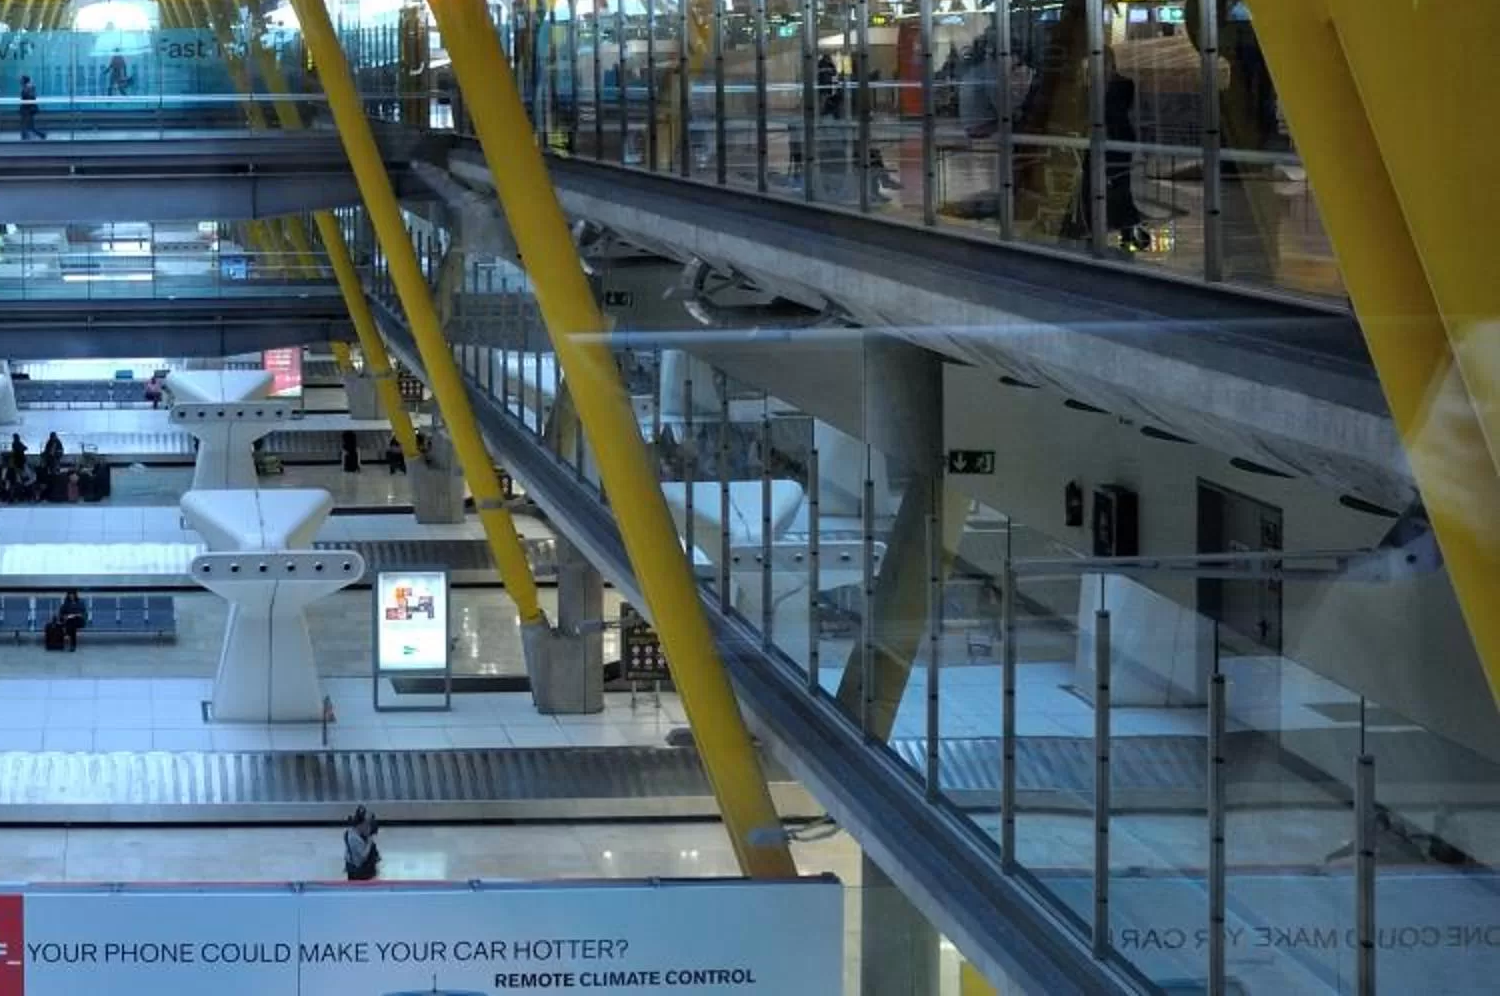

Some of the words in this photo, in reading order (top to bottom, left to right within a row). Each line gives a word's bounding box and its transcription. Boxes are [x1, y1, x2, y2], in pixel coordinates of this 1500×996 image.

[157, 38, 206, 59] Fast
[27, 943, 97, 963] YOUR
[104, 943, 194, 963] PHONE
[201, 942, 291, 963] COULD
[299, 942, 370, 963] MAKE
[376, 941, 447, 962] YOUR
[453, 941, 507, 961] CAR
[514, 939, 629, 960] HOTTER?
[495, 972, 575, 989] REMOTE
[579, 970, 660, 987] CLIMATE
[665, 968, 757, 985] CONTROL
